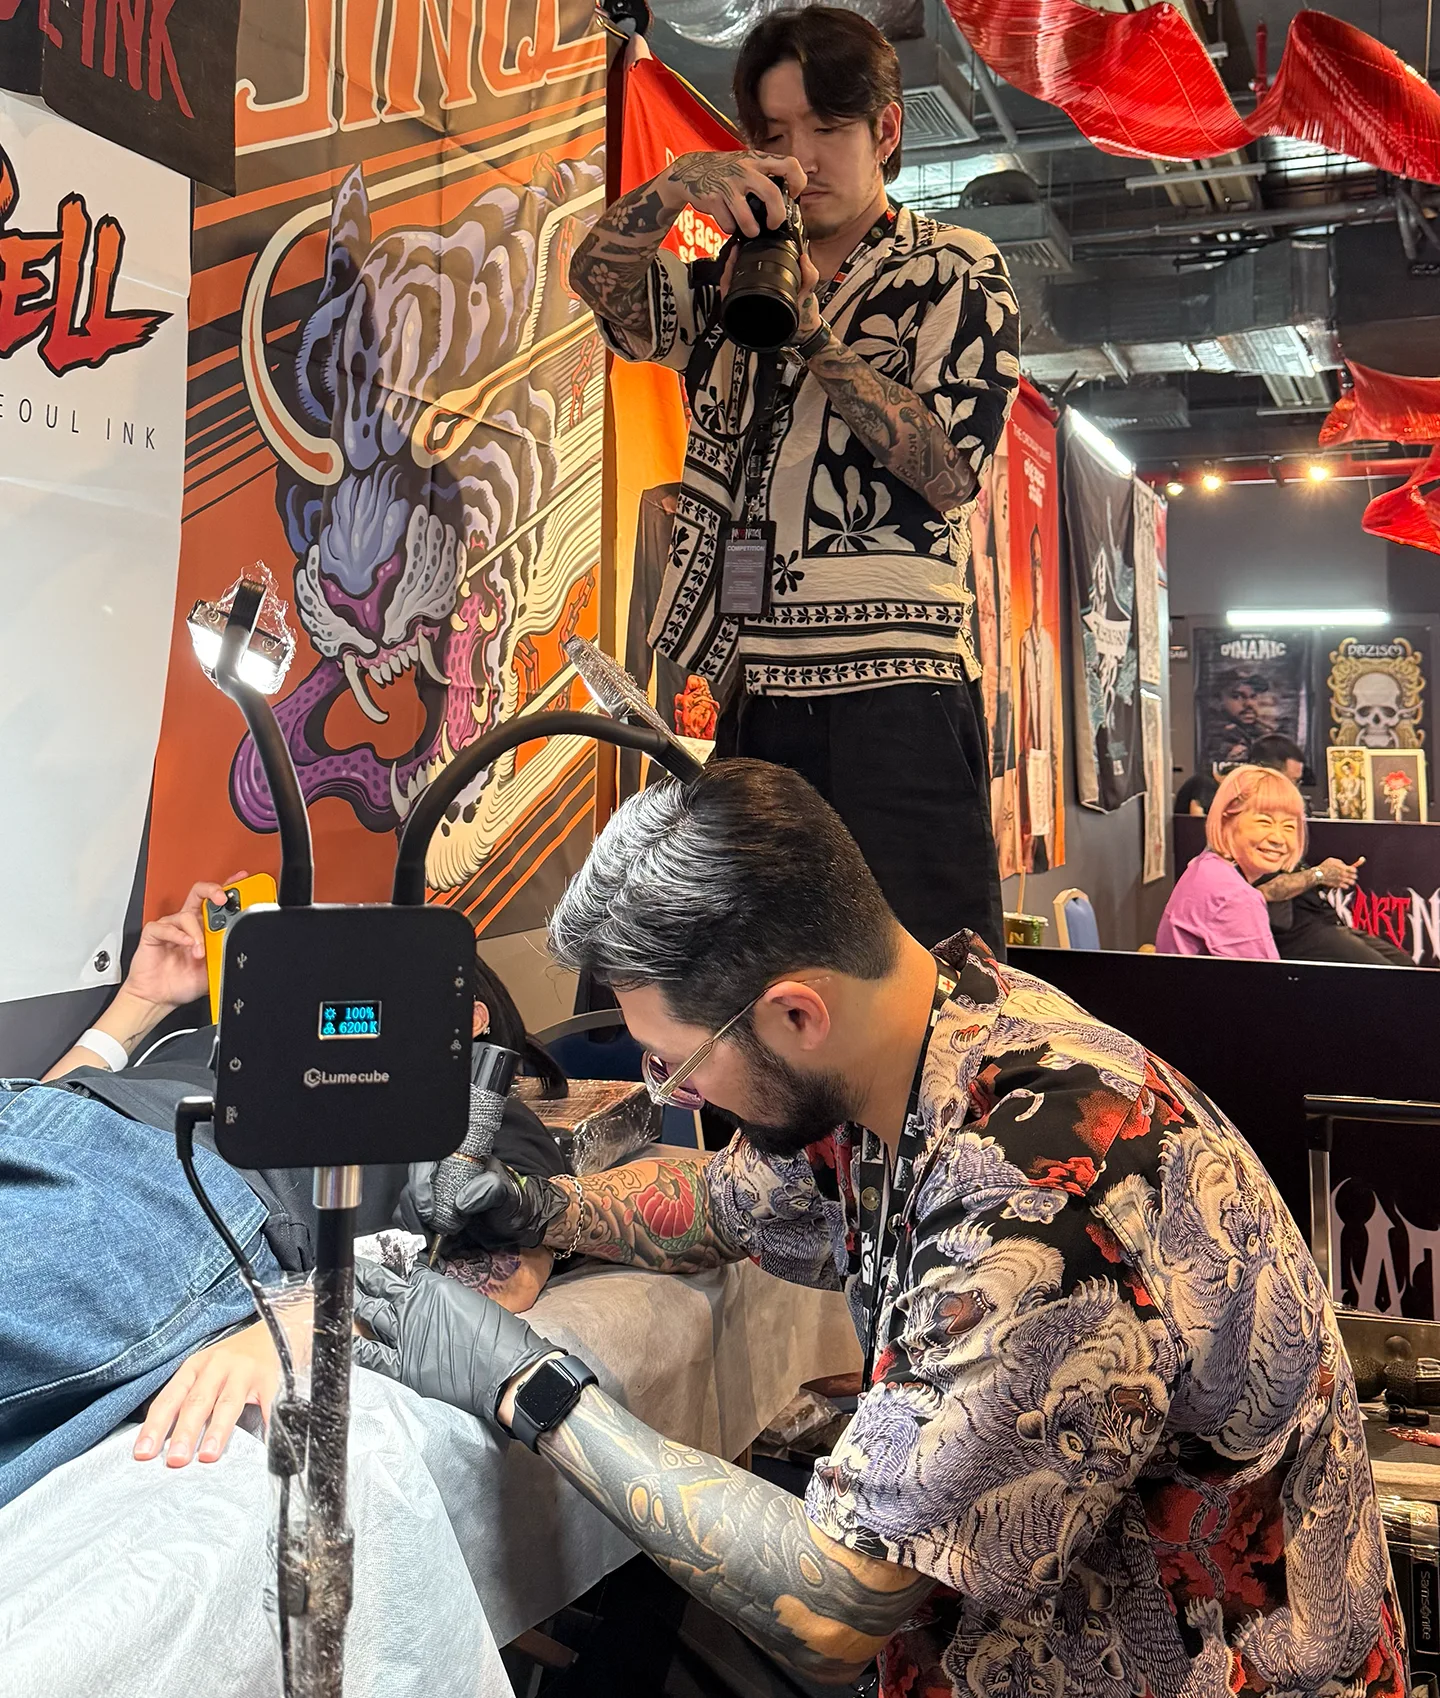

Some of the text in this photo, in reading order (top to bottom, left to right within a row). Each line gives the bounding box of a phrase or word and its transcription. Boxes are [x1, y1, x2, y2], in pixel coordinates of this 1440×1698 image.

[0, 394, 156, 450] OUL INK
[345, 1007, 375, 1020] 100%
[321, 1070, 390, 1084] Lumecube
